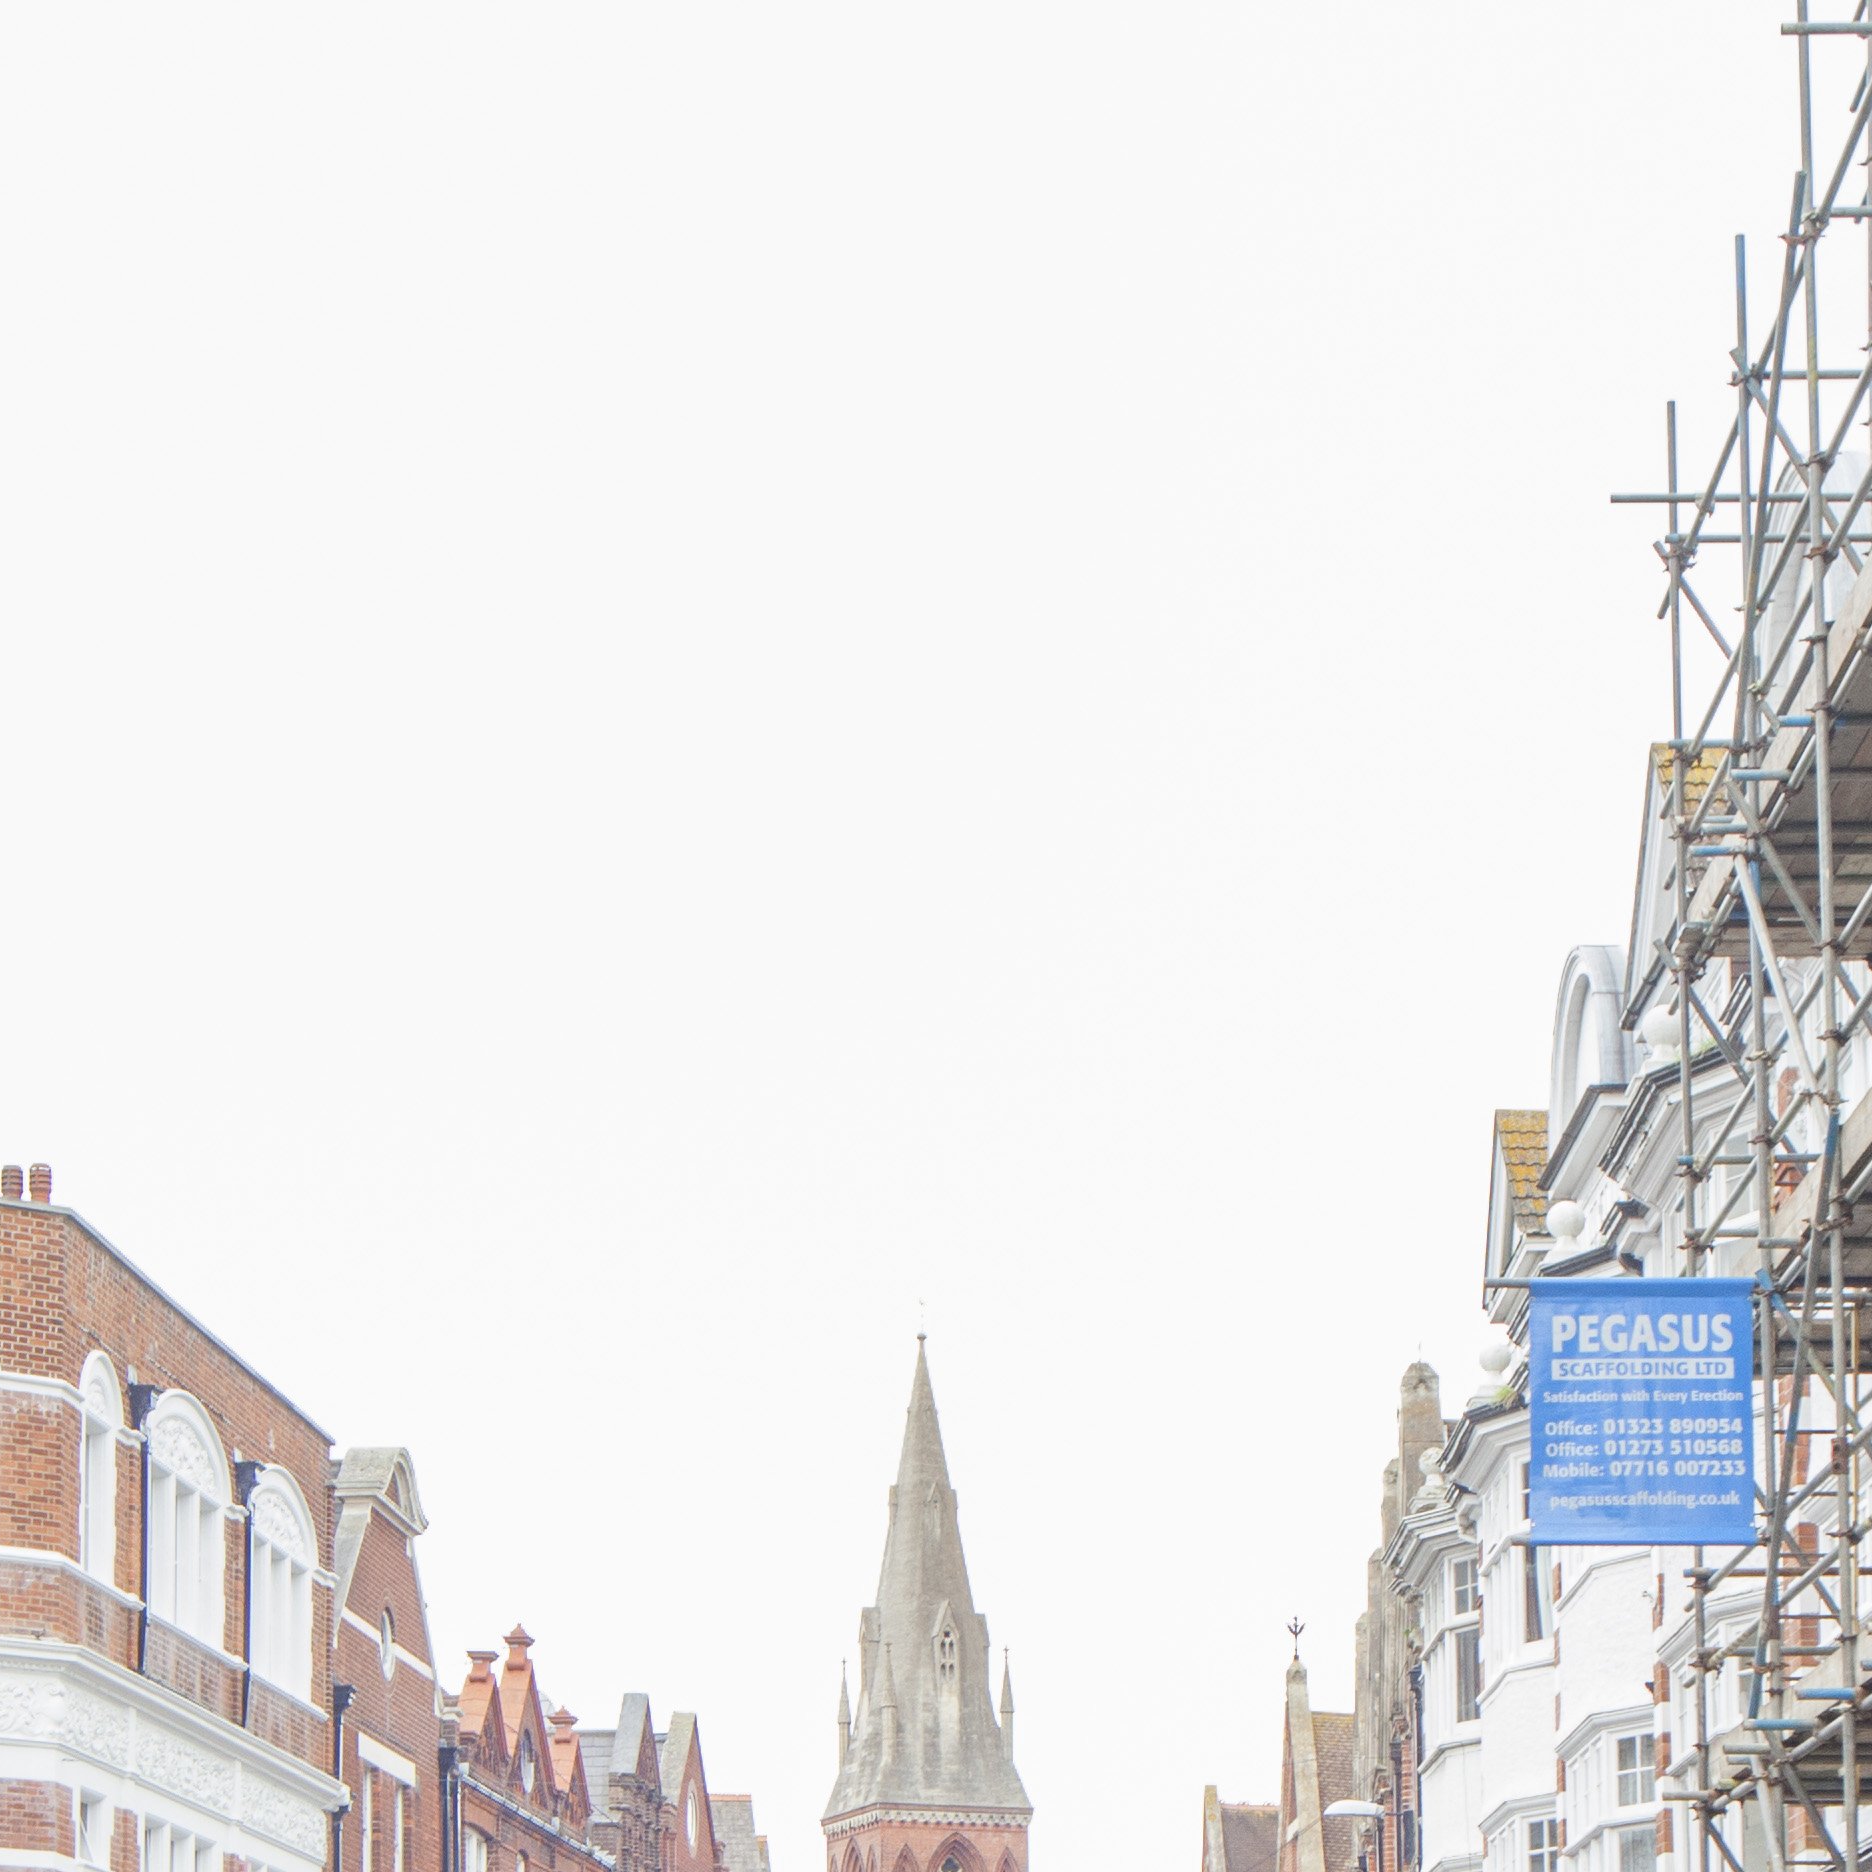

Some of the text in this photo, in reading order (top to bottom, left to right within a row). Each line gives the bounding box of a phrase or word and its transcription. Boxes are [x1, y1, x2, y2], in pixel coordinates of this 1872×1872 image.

[1552, 1314, 1734, 1352] PEGASUS
[1559, 1361, 1727, 1377] SCAFFOLDING LTD
[1544, 1389, 1744, 1404] Satisfaction with Every Erection
[1545, 1418, 1743, 1435] Office: 01323 890954
[1546, 1439, 1743, 1457] Office: 01273 510568
[1543, 1460, 1746, 1478] Mobile: 07716 007233
[1550, 1490, 1740, 1510] pegasusscaffolding.co.uk
